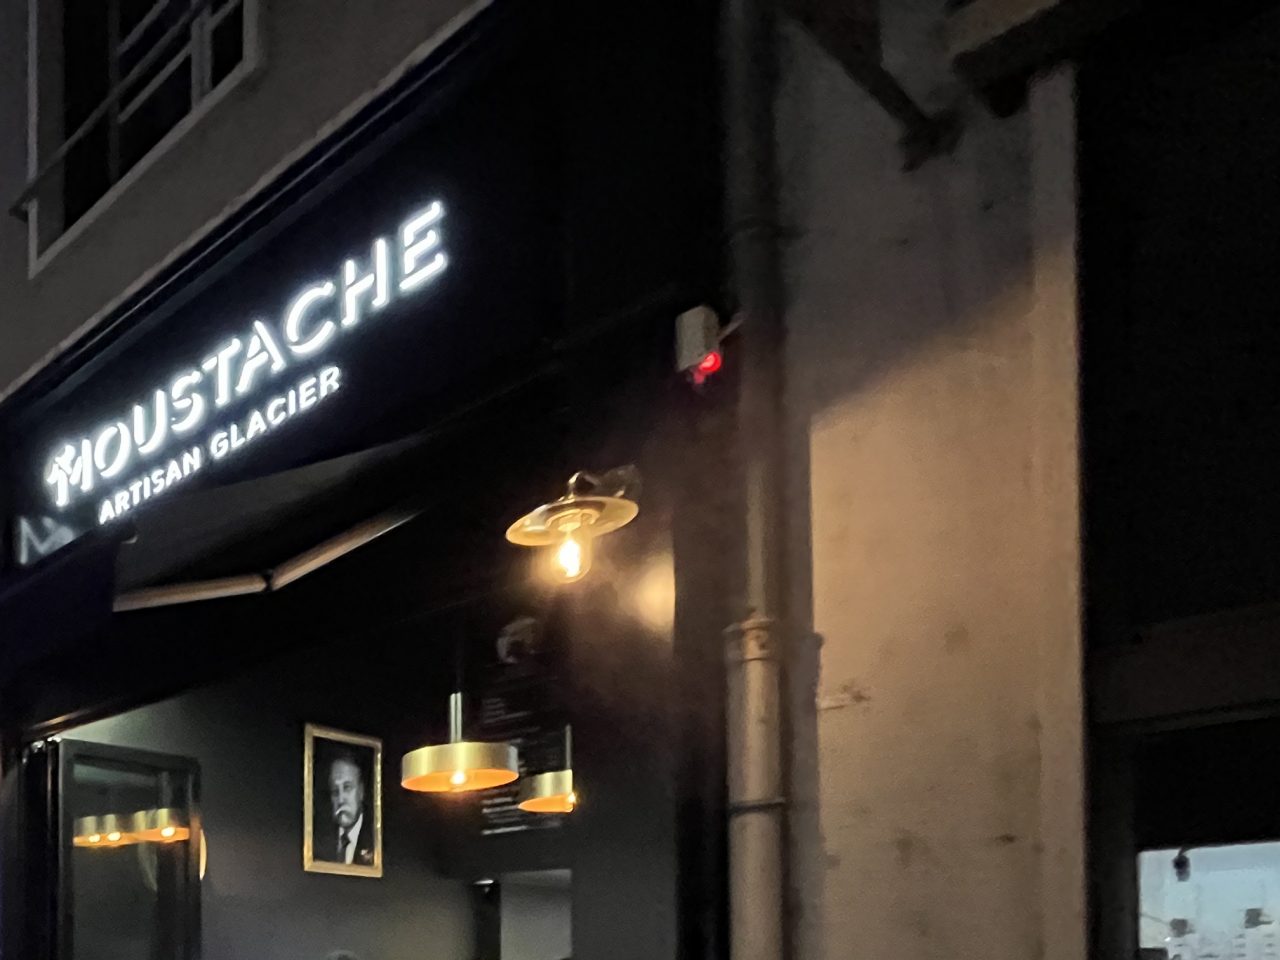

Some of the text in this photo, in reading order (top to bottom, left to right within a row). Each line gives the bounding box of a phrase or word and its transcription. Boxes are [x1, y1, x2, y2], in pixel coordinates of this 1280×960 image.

[45, 200, 448, 508] MOUSTACHE
[98, 365, 342, 526] ARTISAN GLACIER
